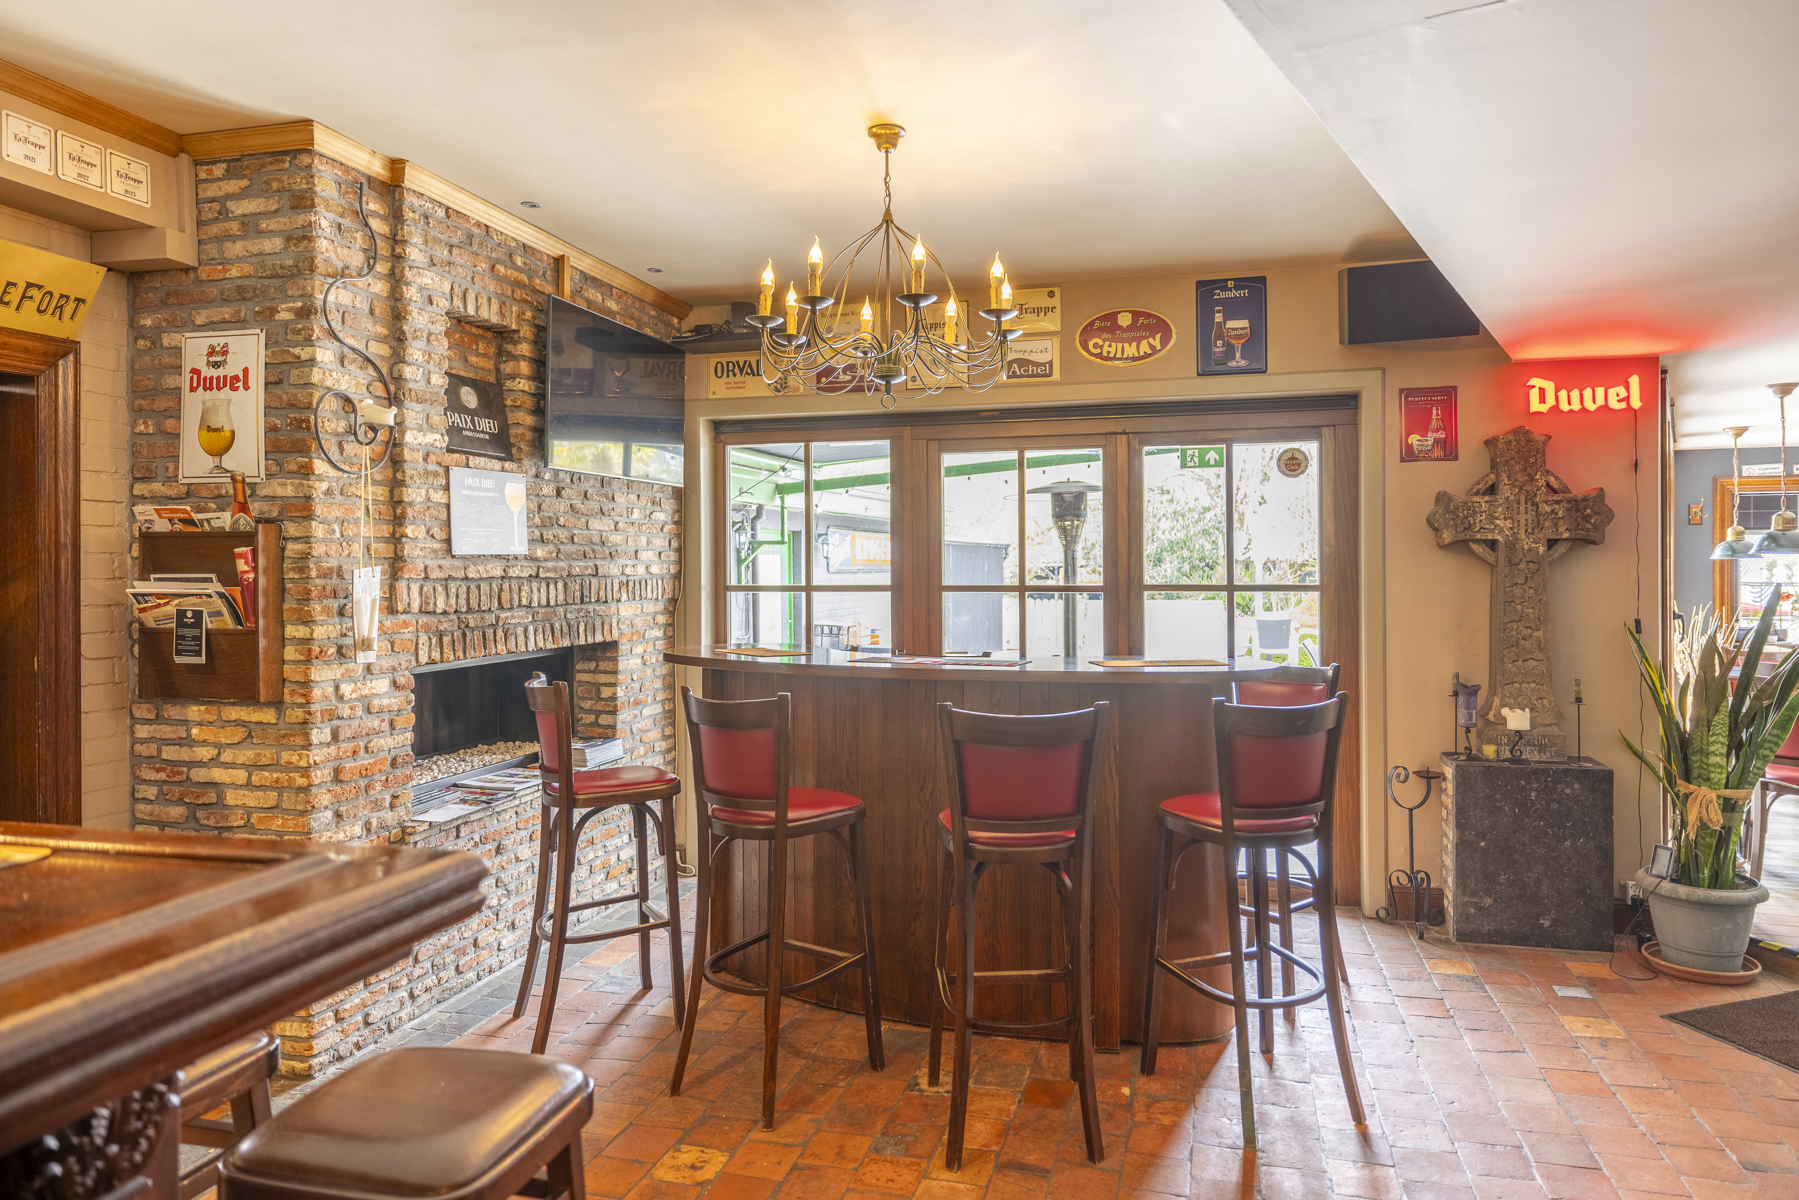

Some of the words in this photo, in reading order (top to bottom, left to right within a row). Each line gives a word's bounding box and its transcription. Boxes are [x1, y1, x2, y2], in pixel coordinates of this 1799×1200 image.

[21, 135, 46, 150] Trappe
[23, 153, 36, 163] 2021
[74, 154, 98, 169] Trappe
[122, 172, 144, 185] Trappe
[1213, 288, 1249, 299] Zundert
[0, 280, 87, 323] EFORT
[1014, 302, 1057, 319] Trappe
[1093, 320, 1111, 329] Bière
[1137, 317, 1157, 327] Forte
[1115, 330, 1150, 339] Trappistes
[1008, 346, 1050, 356] Trappist
[1088, 332, 1162, 359] CHIMAY
[714, 359, 766, 379] ORVAL
[1008, 363, 1050, 376] Achel
[189, 366, 251, 393] Duvel
[1525, 373, 1643, 414] Duvel
[446, 411, 474, 430] PAIX
[474, 416, 498, 434] DIEU
[206, 425, 225, 434] Duvel
[464, 476, 480, 488] PAIX
[481, 478, 495, 489] DIEU
[230, 522, 252, 532] ORVA
[1497, 735, 1508, 744] IN
